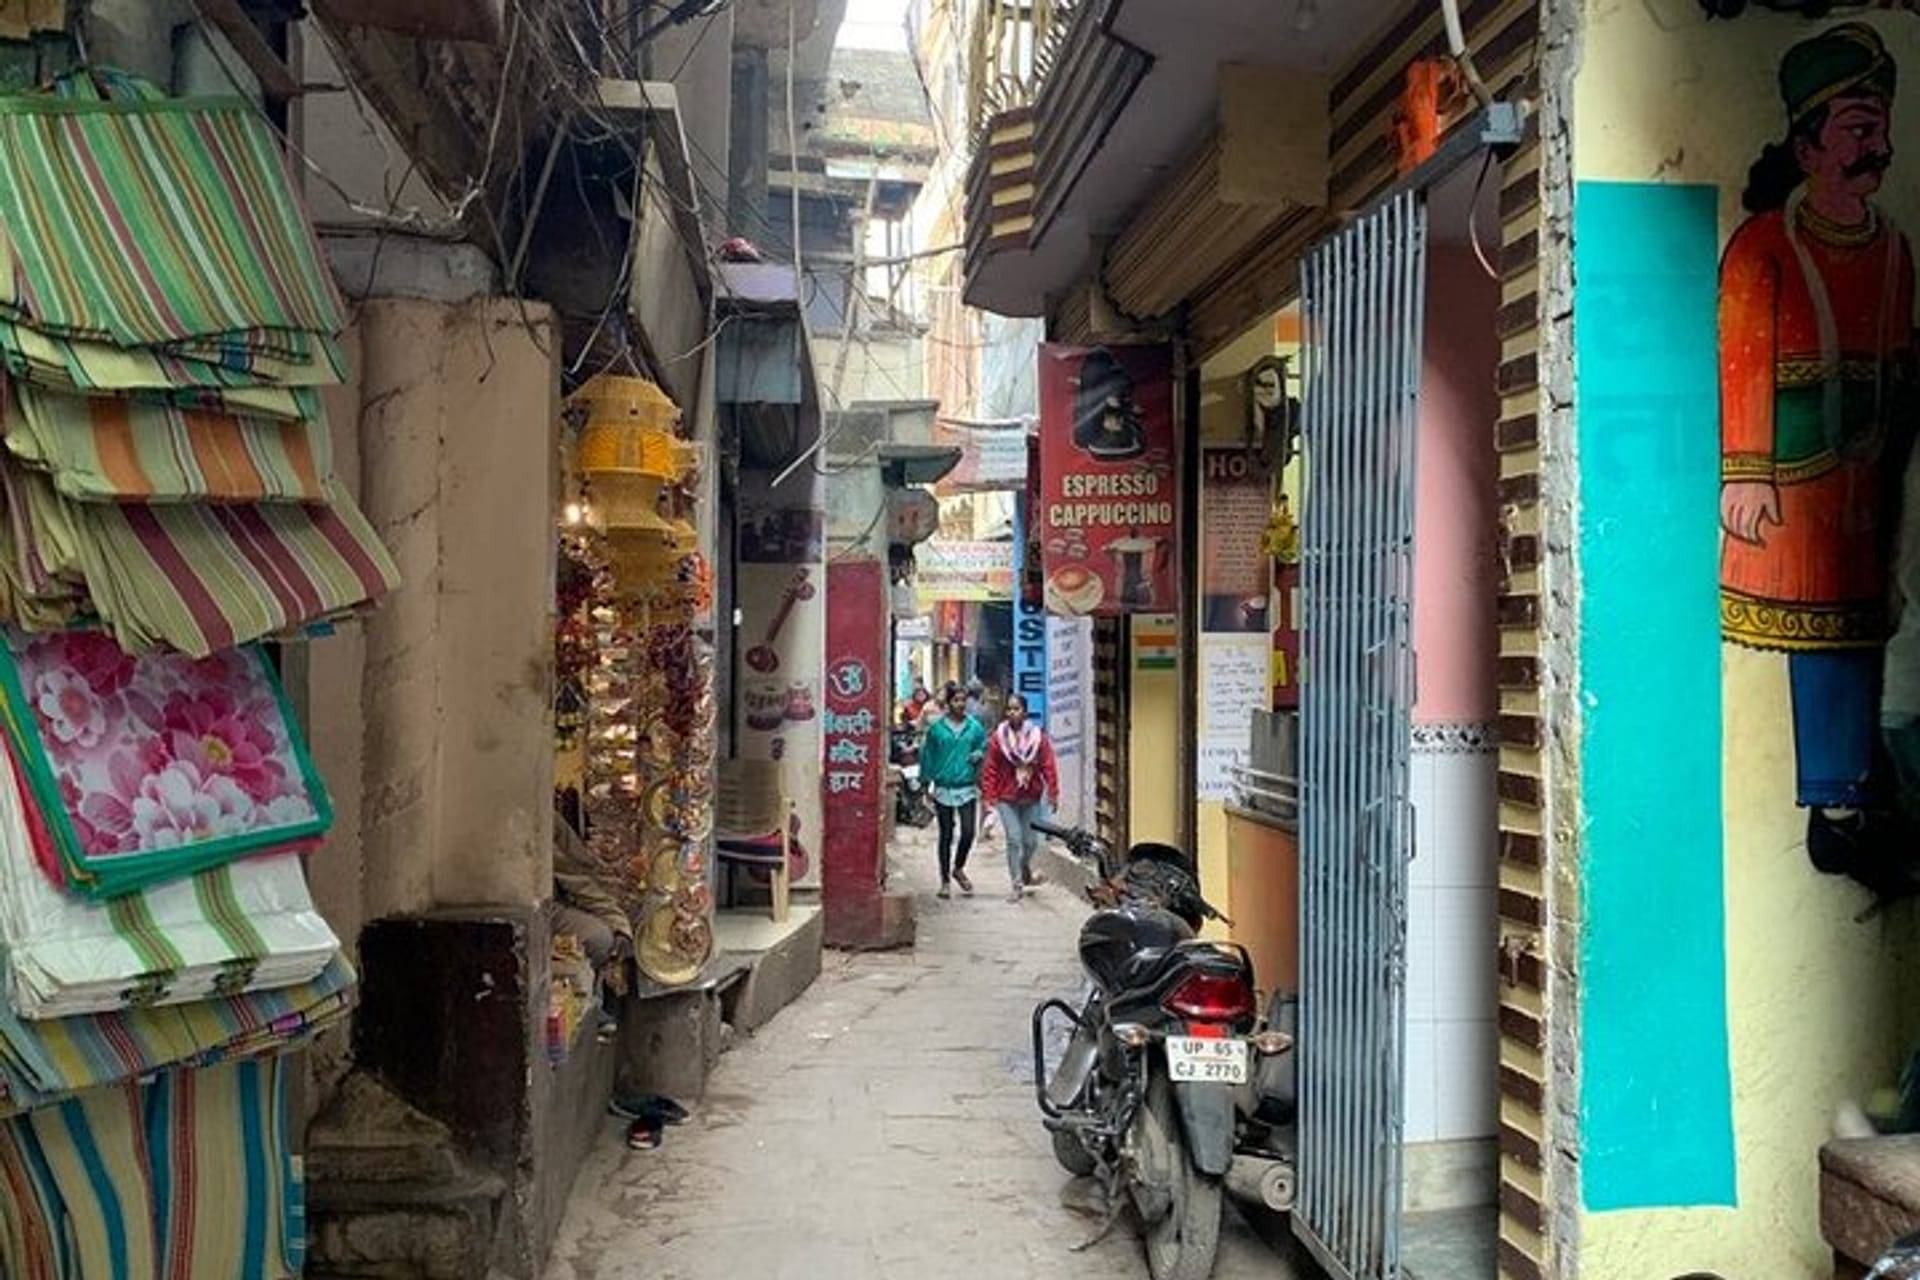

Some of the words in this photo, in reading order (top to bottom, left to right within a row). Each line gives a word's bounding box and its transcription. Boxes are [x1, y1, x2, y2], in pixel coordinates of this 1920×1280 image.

[1062, 473, 1158, 498] ESPRESSO
[1050, 502, 1172, 527] CAPPUCCINO
[1182, 1041, 1204, 1055] UP
[1175, 1061, 1196, 1076] CJ
